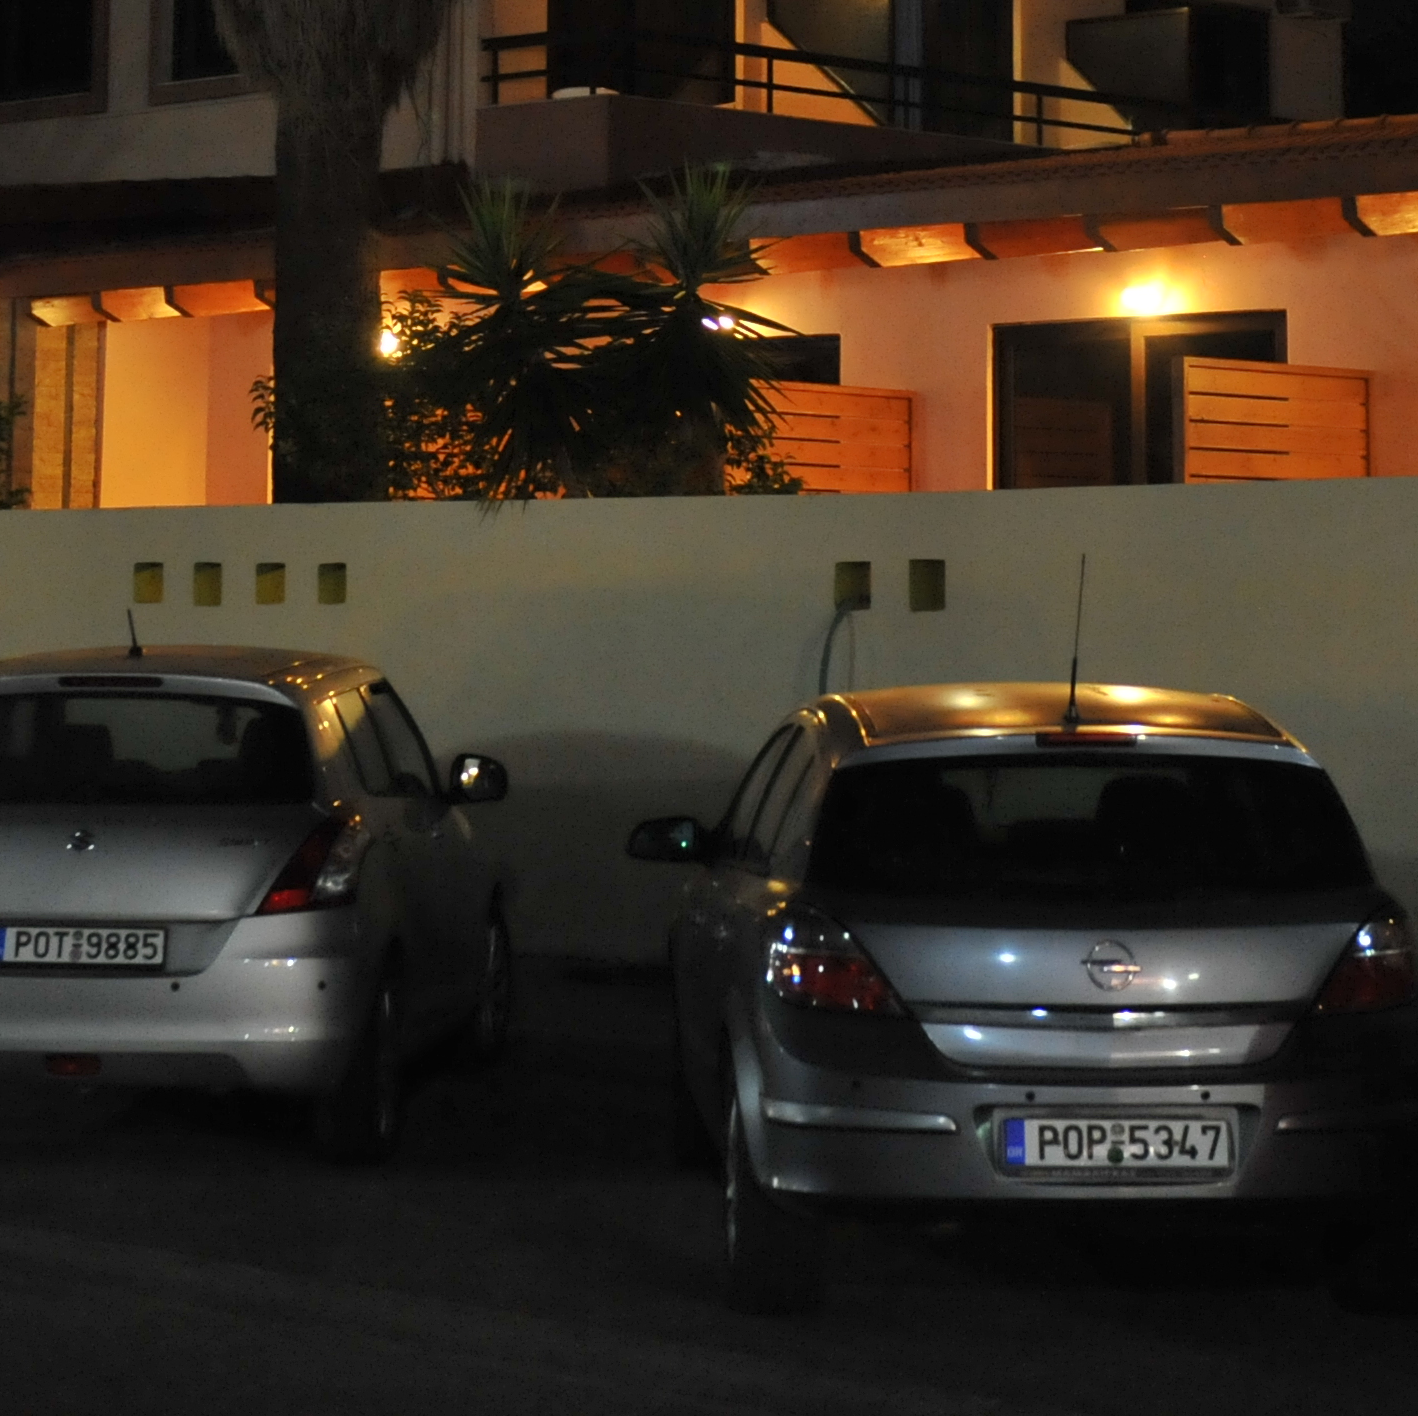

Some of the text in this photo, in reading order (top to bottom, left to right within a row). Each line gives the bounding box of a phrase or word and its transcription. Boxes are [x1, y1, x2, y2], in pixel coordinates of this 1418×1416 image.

[14, 930, 160, 960] POT 9885
[1037, 1124, 1222, 1161] POP 5347
